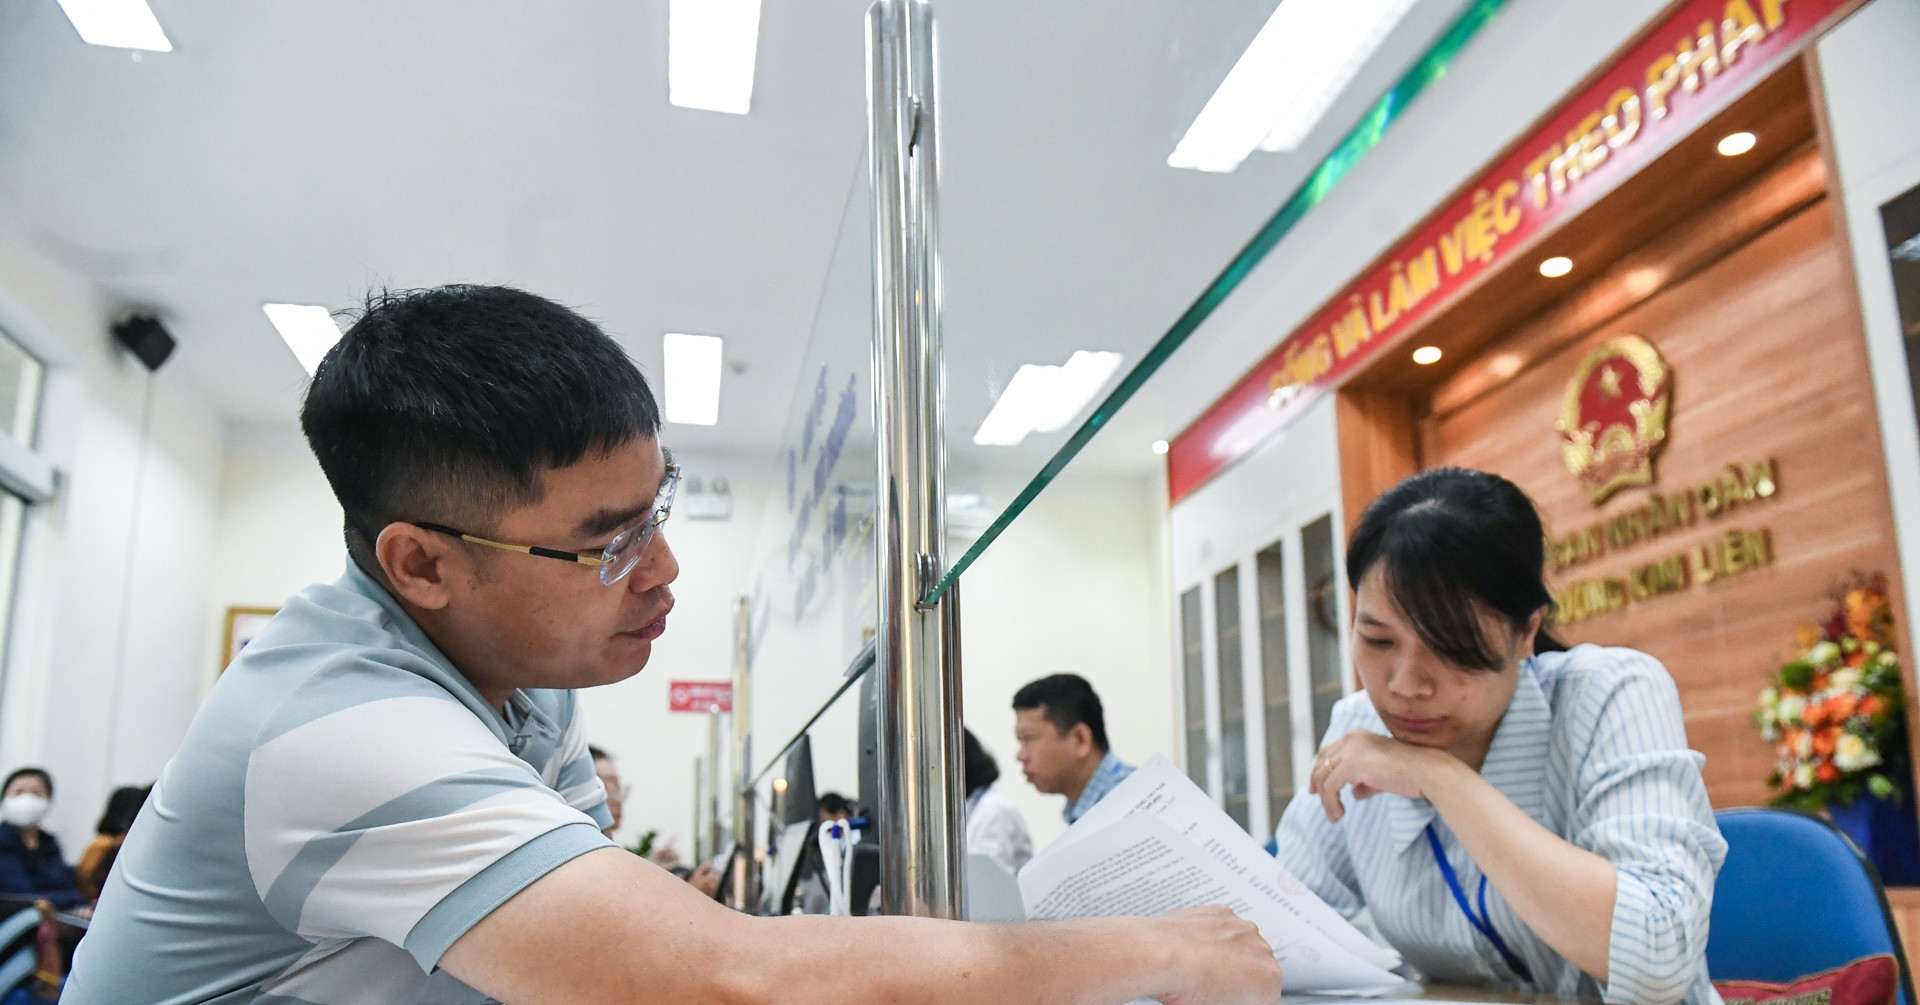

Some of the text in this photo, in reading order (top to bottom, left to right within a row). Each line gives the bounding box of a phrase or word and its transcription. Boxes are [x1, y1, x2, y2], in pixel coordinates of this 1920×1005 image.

[1330, 293, 1371, 359] VÀ
[1369, 260, 1440, 333] LÀM
[1439, 180, 1522, 276] VIỆC
[1523, 86, 1641, 209] THEO
[1699, 459, 1778, 518] DÂN
[1692, 528, 1773, 585] LIÊN
